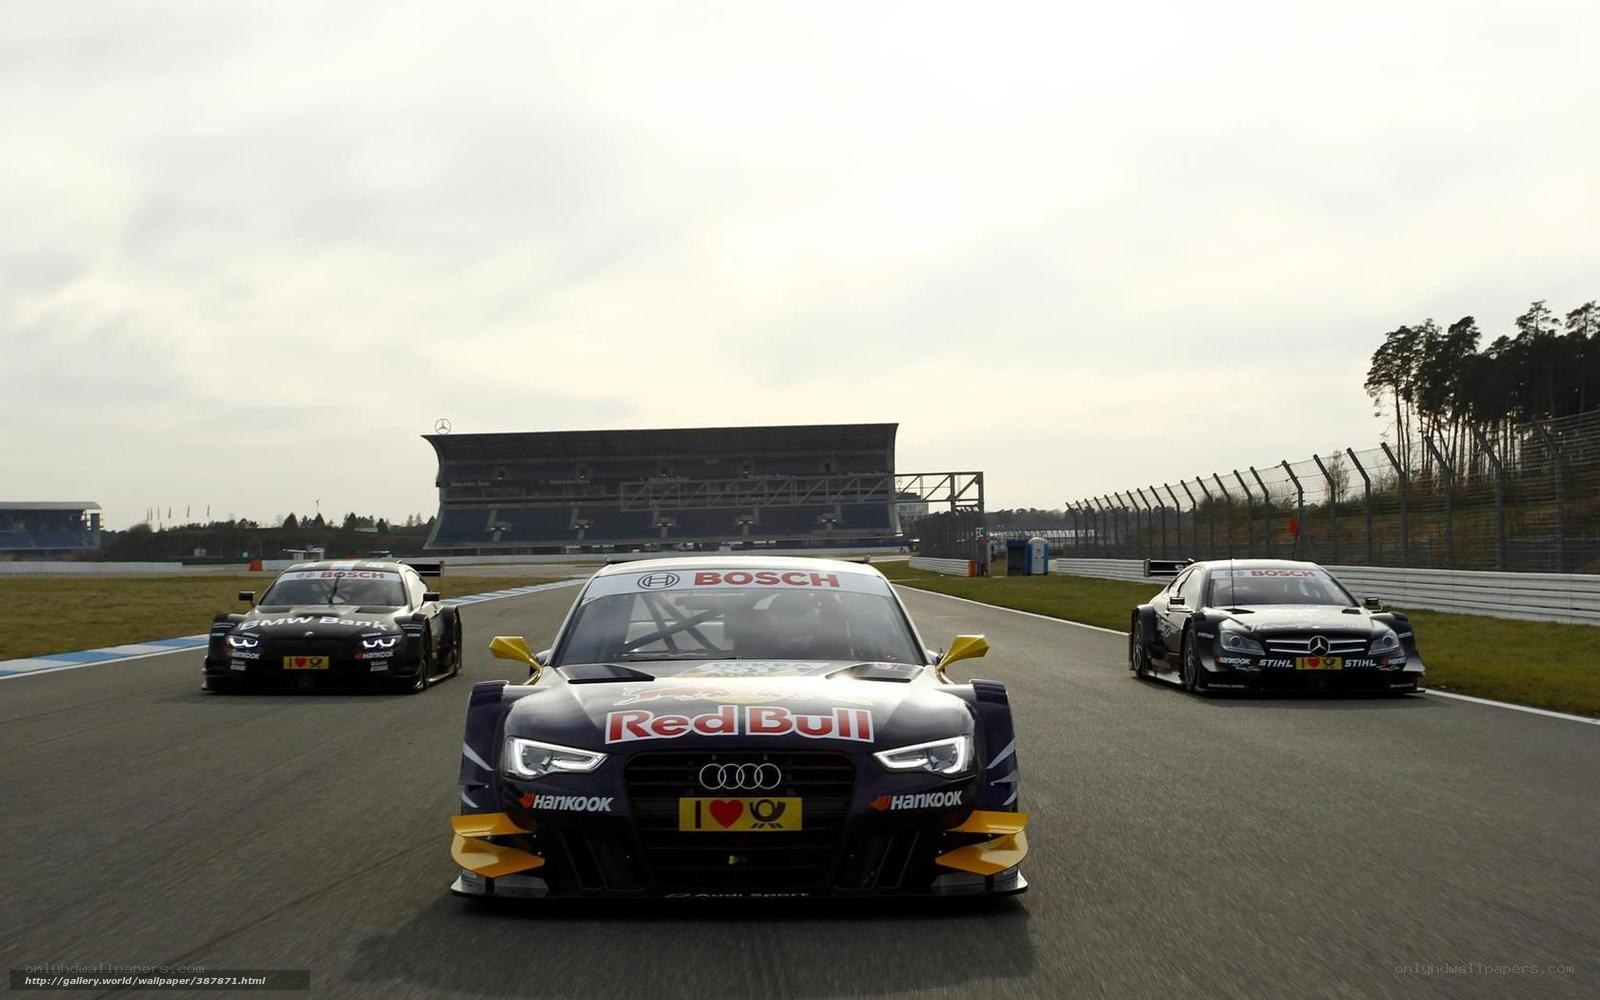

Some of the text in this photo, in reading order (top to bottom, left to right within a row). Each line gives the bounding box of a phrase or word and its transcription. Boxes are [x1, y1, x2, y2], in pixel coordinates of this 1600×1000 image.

[320, 571, 385, 579] BOSCH
[693, 572, 840, 588] BOSCH
[239, 615, 388, 631] BMW Bank
[1258, 659, 1294, 668] STIHL
[1344, 659, 1377, 668] STIHL
[605, 704, 874, 744] Red Bull
